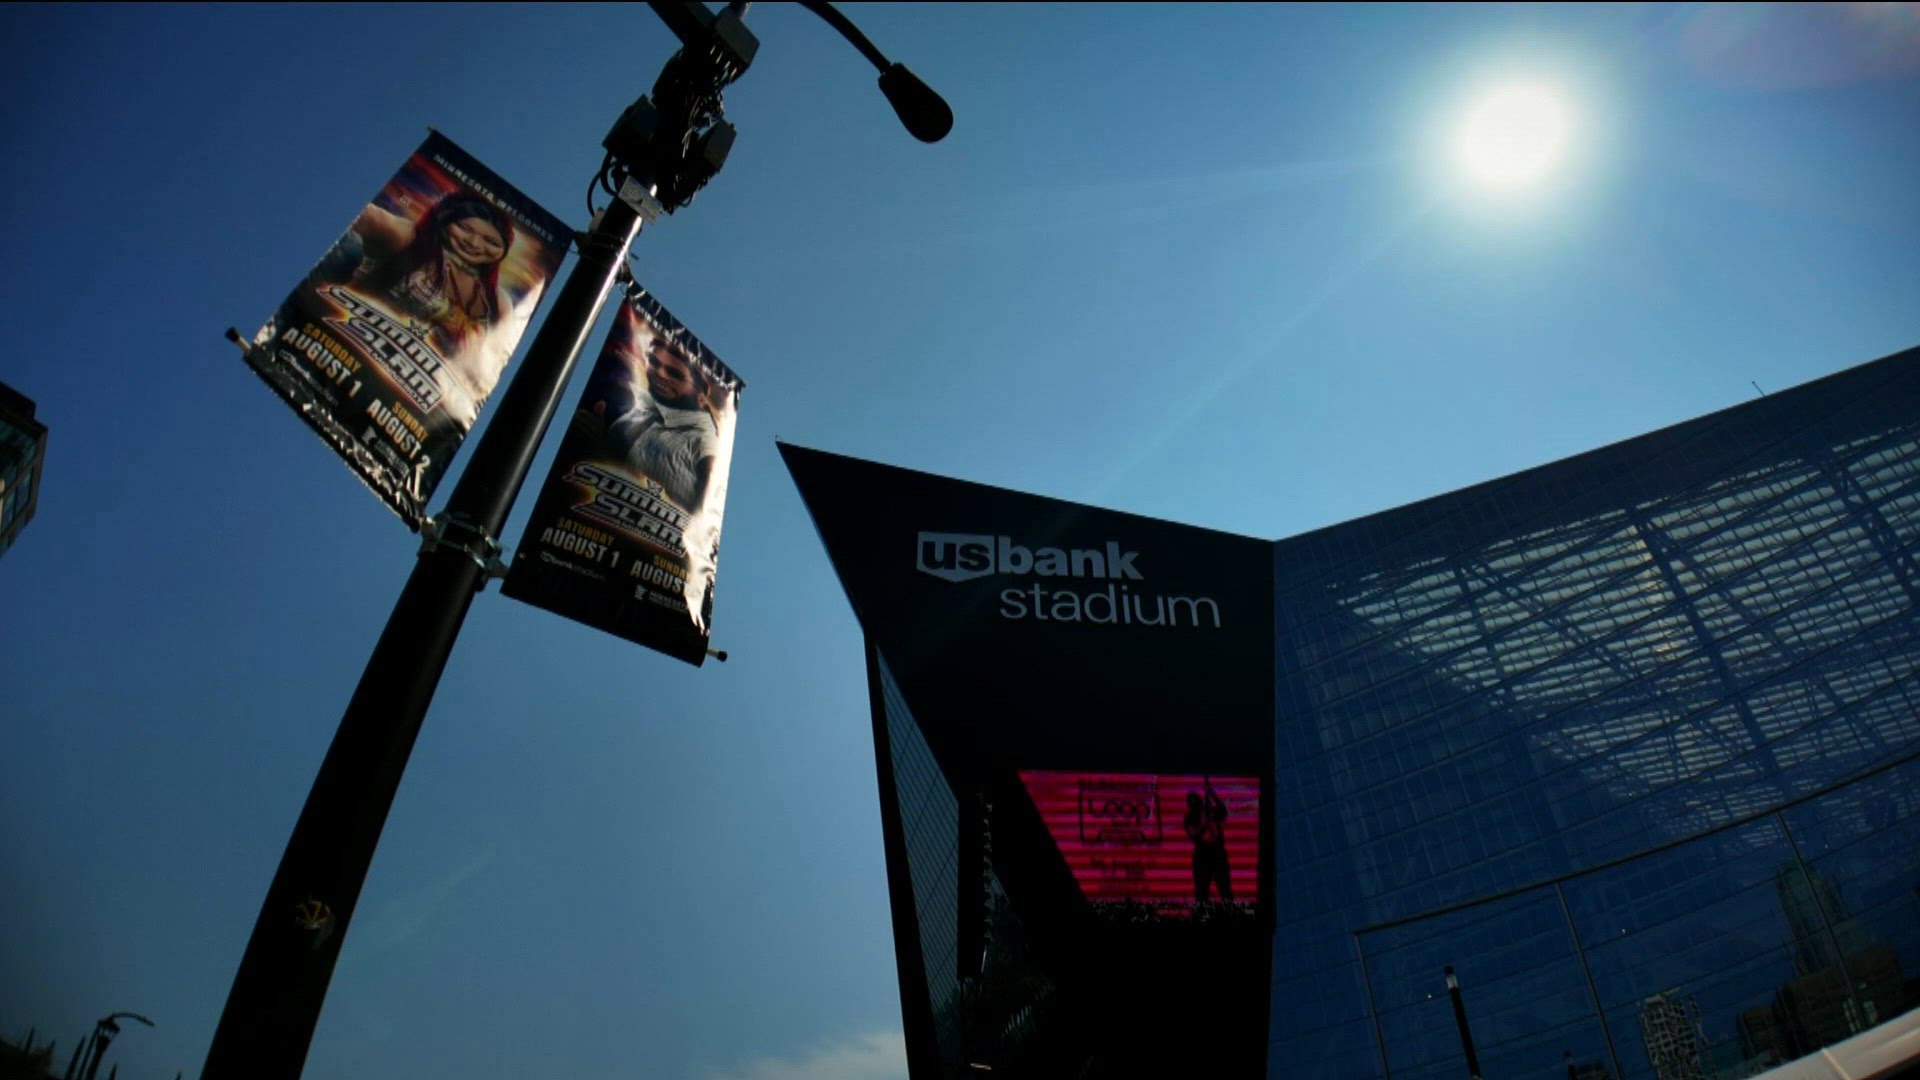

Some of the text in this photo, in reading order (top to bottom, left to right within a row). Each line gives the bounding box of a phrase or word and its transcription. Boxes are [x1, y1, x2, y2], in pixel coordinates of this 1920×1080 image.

[281, 327, 352, 385] AUGUST
[348, 380, 363, 398] 1
[303, 322, 361, 373] SATURDAY
[366, 398, 422, 460] AUGUST
[391, 401, 429, 443] SUNDAY
[541, 526, 609, 563] AUGUST
[609, 550, 620, 569] 1
[556, 516, 616, 547] SATURDAY
[630, 559, 687, 595] AUGUS
[653, 554, 688, 581] SUNDA
[999, 582, 1221, 628] stadium
